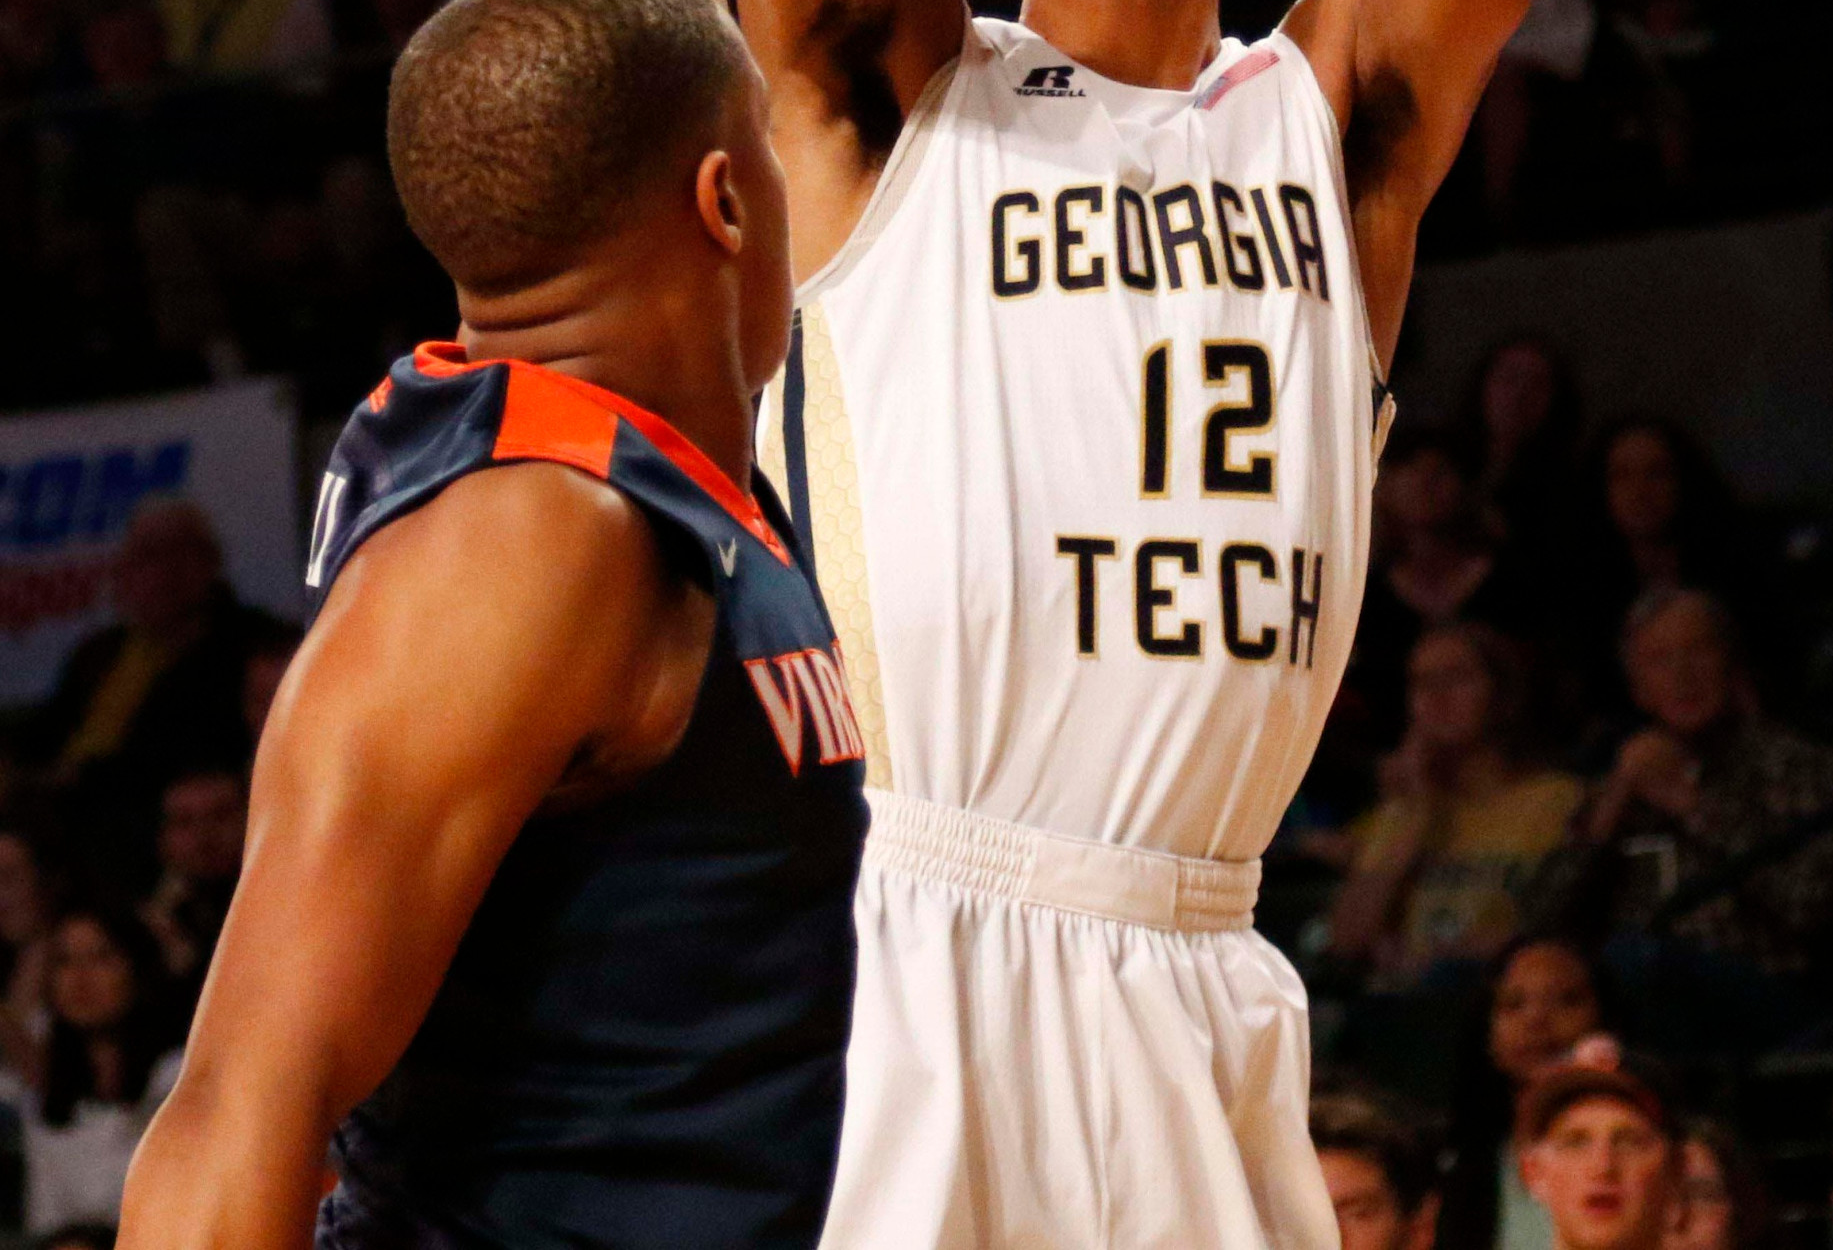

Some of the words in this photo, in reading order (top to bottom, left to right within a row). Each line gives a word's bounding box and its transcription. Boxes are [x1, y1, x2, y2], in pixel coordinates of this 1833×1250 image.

[991, 180, 1331, 302] GEORGIA
[1137, 336, 1278, 501] 12
[1054, 533, 1323, 670] TECH
[743, 637, 866, 777] VIR
